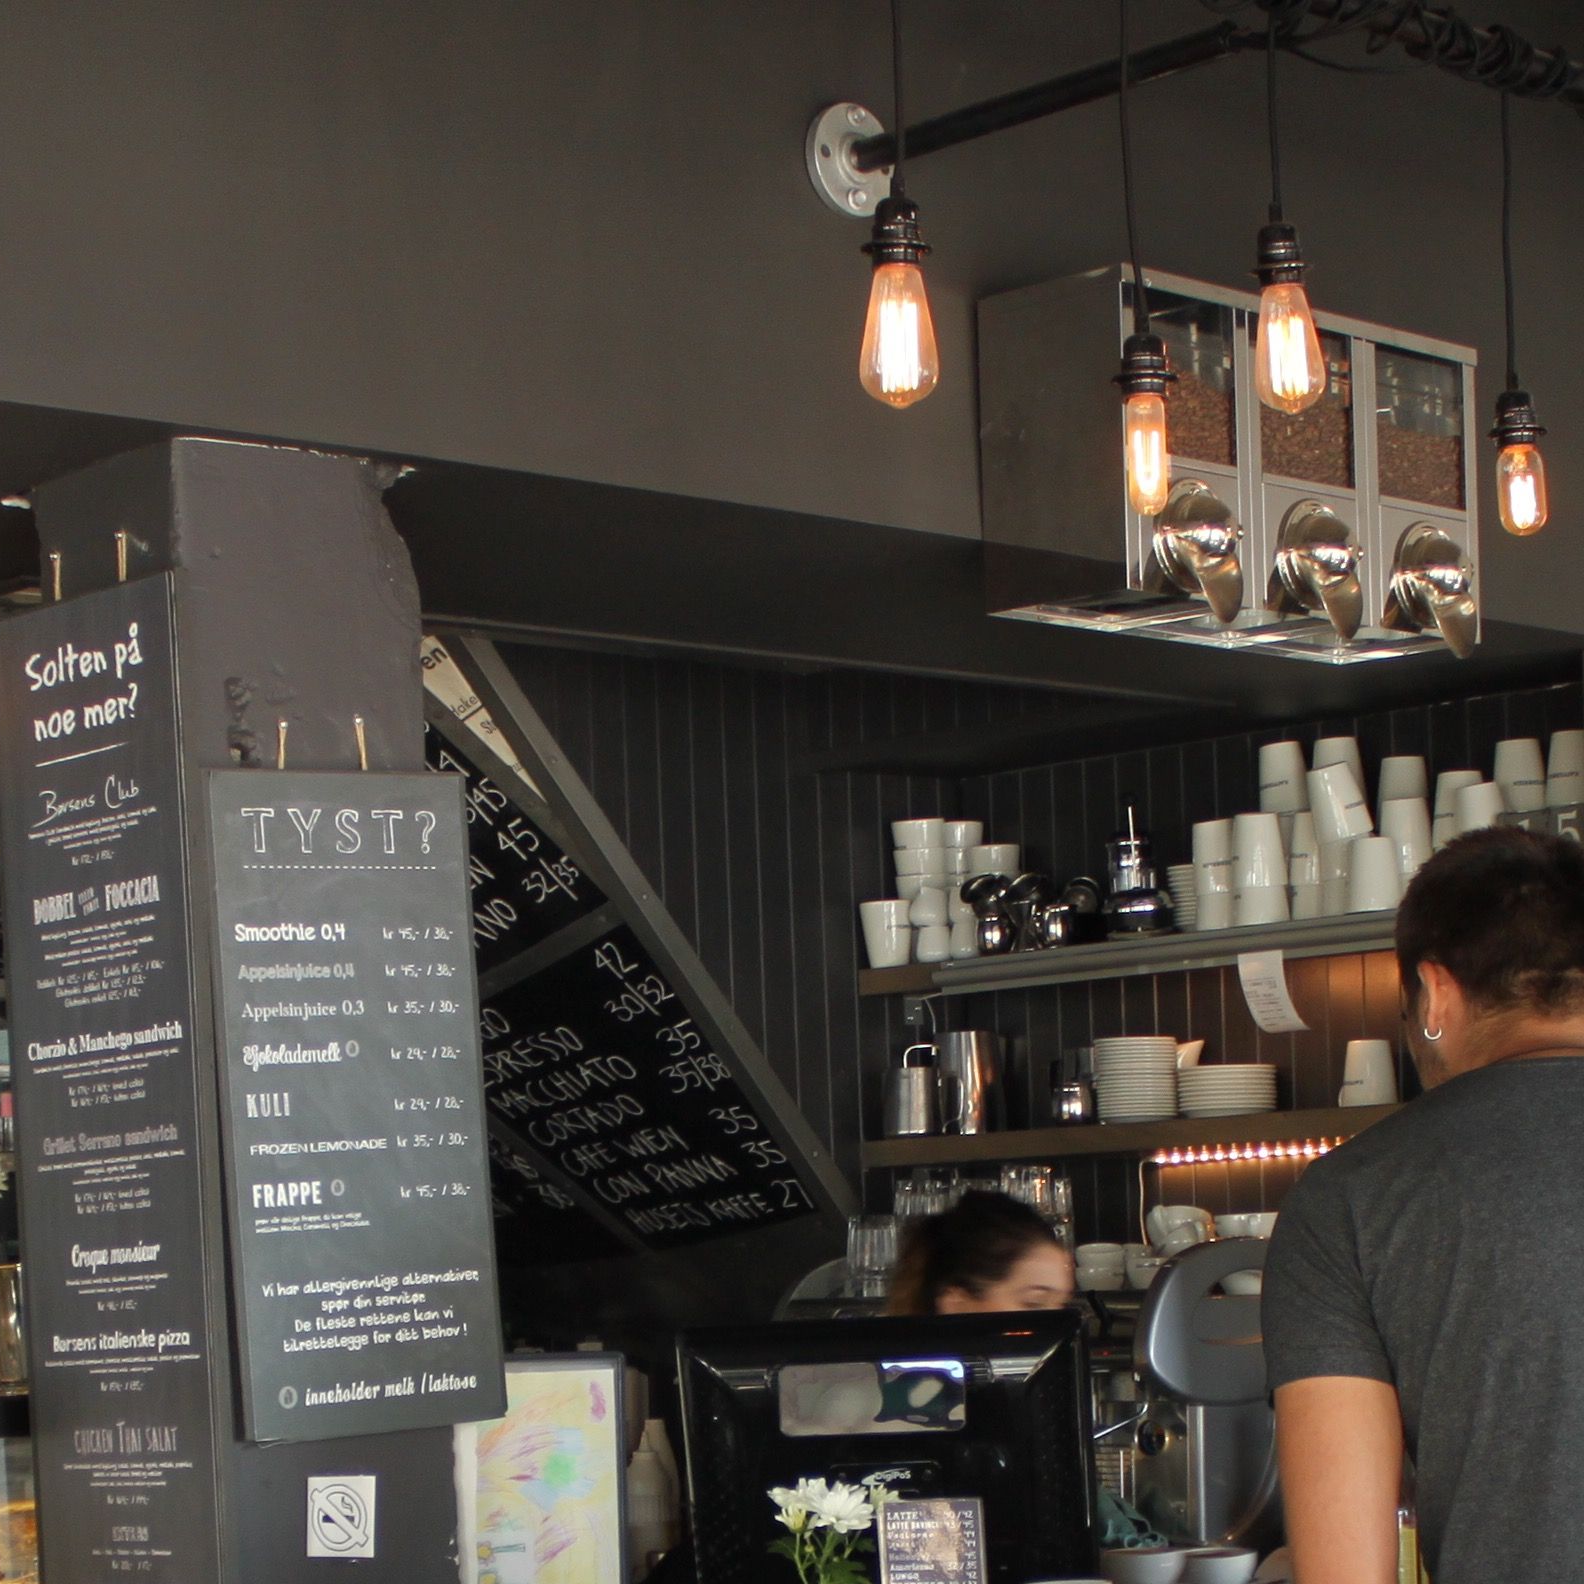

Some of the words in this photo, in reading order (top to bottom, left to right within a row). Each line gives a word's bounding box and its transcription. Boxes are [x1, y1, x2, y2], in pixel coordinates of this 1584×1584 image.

[25, 643, 107, 691] Solten
[115, 622, 142, 679] på
[34, 708, 75, 741] noe
[84, 683, 137, 729] mer?
[105, 774, 139, 808] Club
[241, 808, 436, 854] TYST?
[498, 817, 539, 860] 45
[522, 856, 579, 903] 32/35
[33, 892, 76, 925] DOBBEL
[105, 875, 160, 911] FOCCACIA
[235, 924, 316, 941] Smoothie
[321, 923, 345, 941] 0,4
[239, 964, 330, 982] Appelsinjuice
[595, 943, 639, 979] 42
[242, 1002, 336, 1021] Appelsinjuice
[604, 975, 674, 1021] 30/32
[28, 1039, 66, 1061] Chorzio
[68, 1037, 78, 1055] &
[80, 1030, 132, 1053] Manchego
[134, 1021, 182, 1044] sandwich
[656, 1019, 700, 1056] 35
[491, 1056, 636, 1119] MACCHIATO
[246, 1092, 290, 1118] KULI
[529, 1094, 643, 1146] CORTADO
[709, 1106, 758, 1134] 35
[125, 1124, 178, 1146] sandwich
[250, 1143, 308, 1155] FROZEN
[310, 1139, 387, 1153] LEMONADE
[561, 1143, 616, 1176] CAFE
[615, 1125, 689, 1158] WIEN
[741, 1140, 787, 1168] 35
[252, 1181, 322, 1208] FRAPPE
[594, 1172, 649, 1203] CON
[645, 1155, 739, 1193] PANNA
[771, 1180, 814, 1209] 27
[72, 1244, 109, 1274] Croque
[110, 1241, 161, 1265] monsieur
[262, 1284, 273, 1297] Vi
[277, 1283, 299, 1295] har
[353, 1295, 372, 1308] din
[295, 1319, 311, 1333] De
[316, 1315, 355, 1329] fleste
[360, 1312, 410, 1326] rettene
[414, 1309, 438, 1322] kan
[442, 1305, 453, 1318] vi
[100, 1329, 155, 1350] italienske
[158, 1330, 190, 1353] pizza
[284, 1335, 368, 1352] tilrettelegge
[373, 1333, 391, 1344] for
[395, 1329, 419, 1342] ditt
[423, 1326, 459, 1340] behov
[305, 1382, 380, 1406] inneholder
[385, 1378, 415, 1397] melk
[145, 1427, 178, 1452] SALAT
